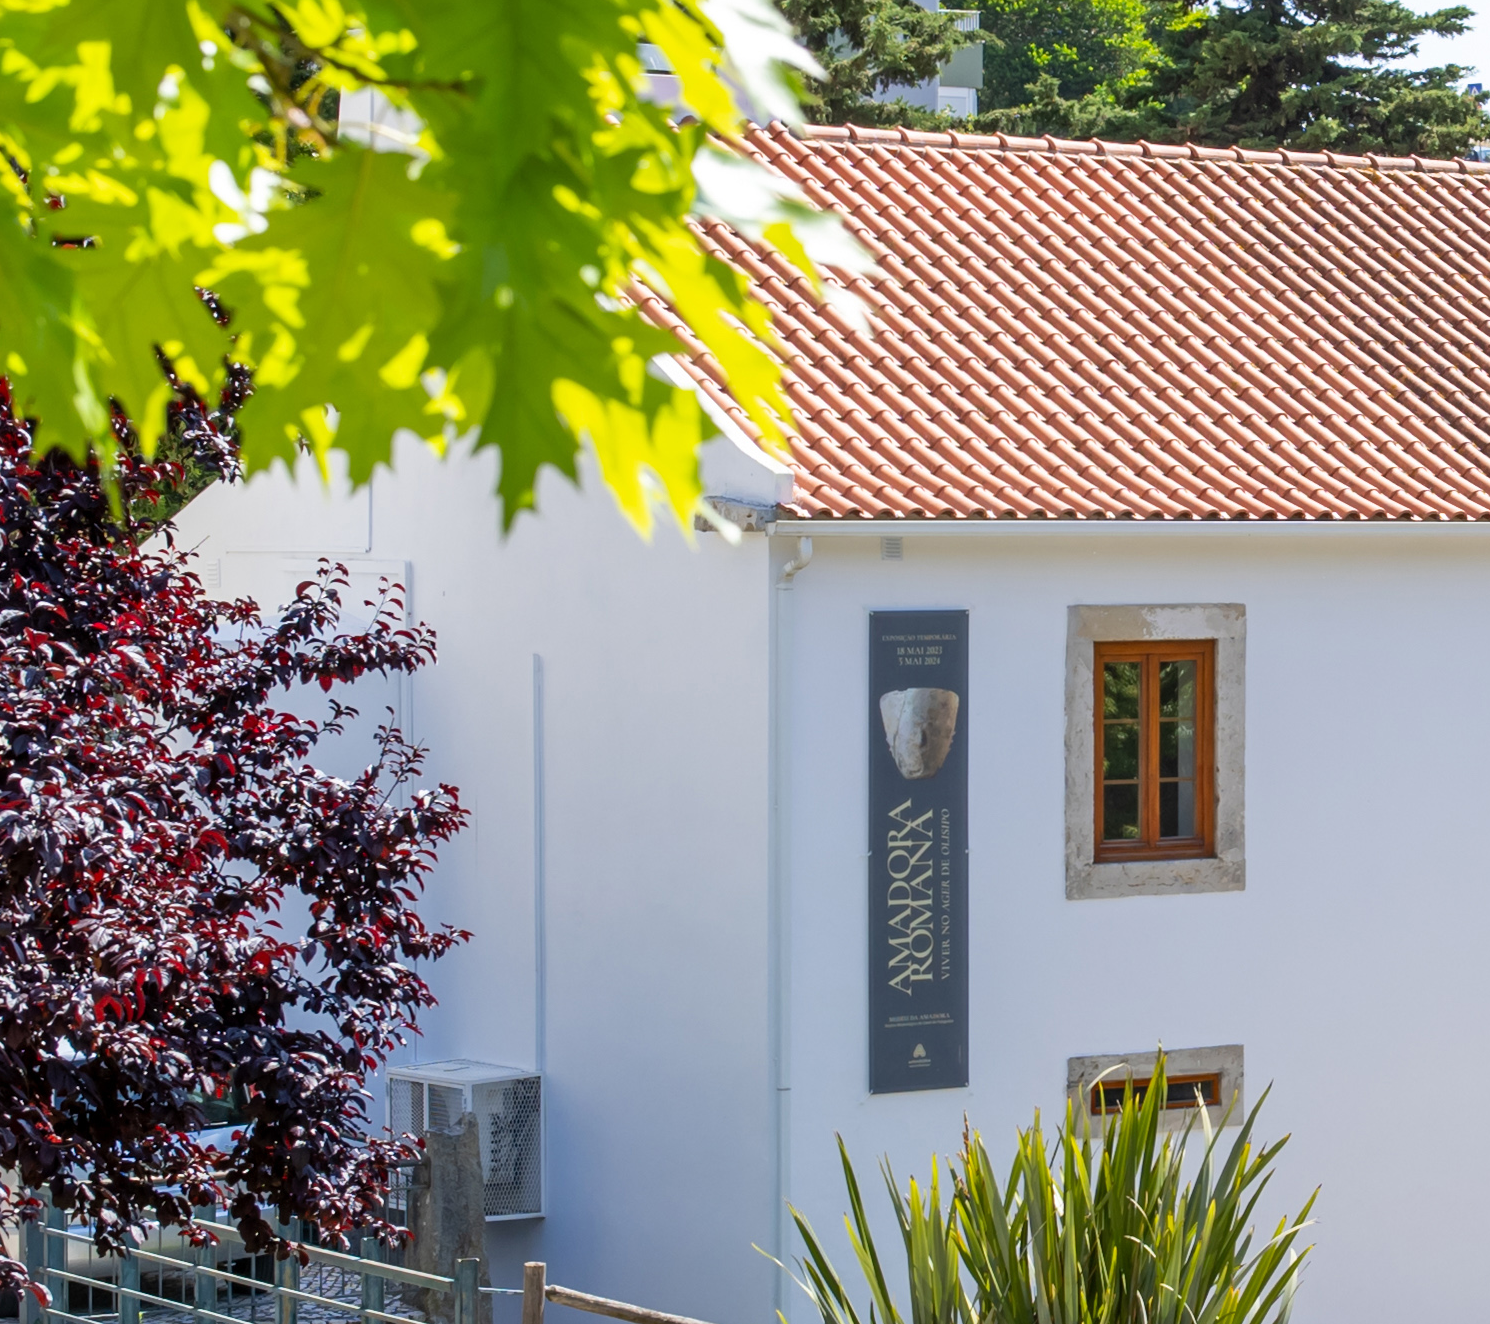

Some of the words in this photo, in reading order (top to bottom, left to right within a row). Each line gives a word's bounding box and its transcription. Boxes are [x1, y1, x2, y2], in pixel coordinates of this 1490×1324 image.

[897, 647, 905, 655] 18
[906, 647, 924, 655] MAI
[926, 646, 943, 655] 2023
[905, 657, 922, 665] MAI
[924, 657, 940, 665] 2024
[940, 808, 950, 856] OLISIPO
[941, 859, 950, 876] DE
[887, 798, 912, 996] AMADORA
[910, 808, 934, 982] ROMANA
[941, 879, 950, 913] AGER
[941, 915, 950, 935] NO
[941, 939, 950, 980] VIVER
